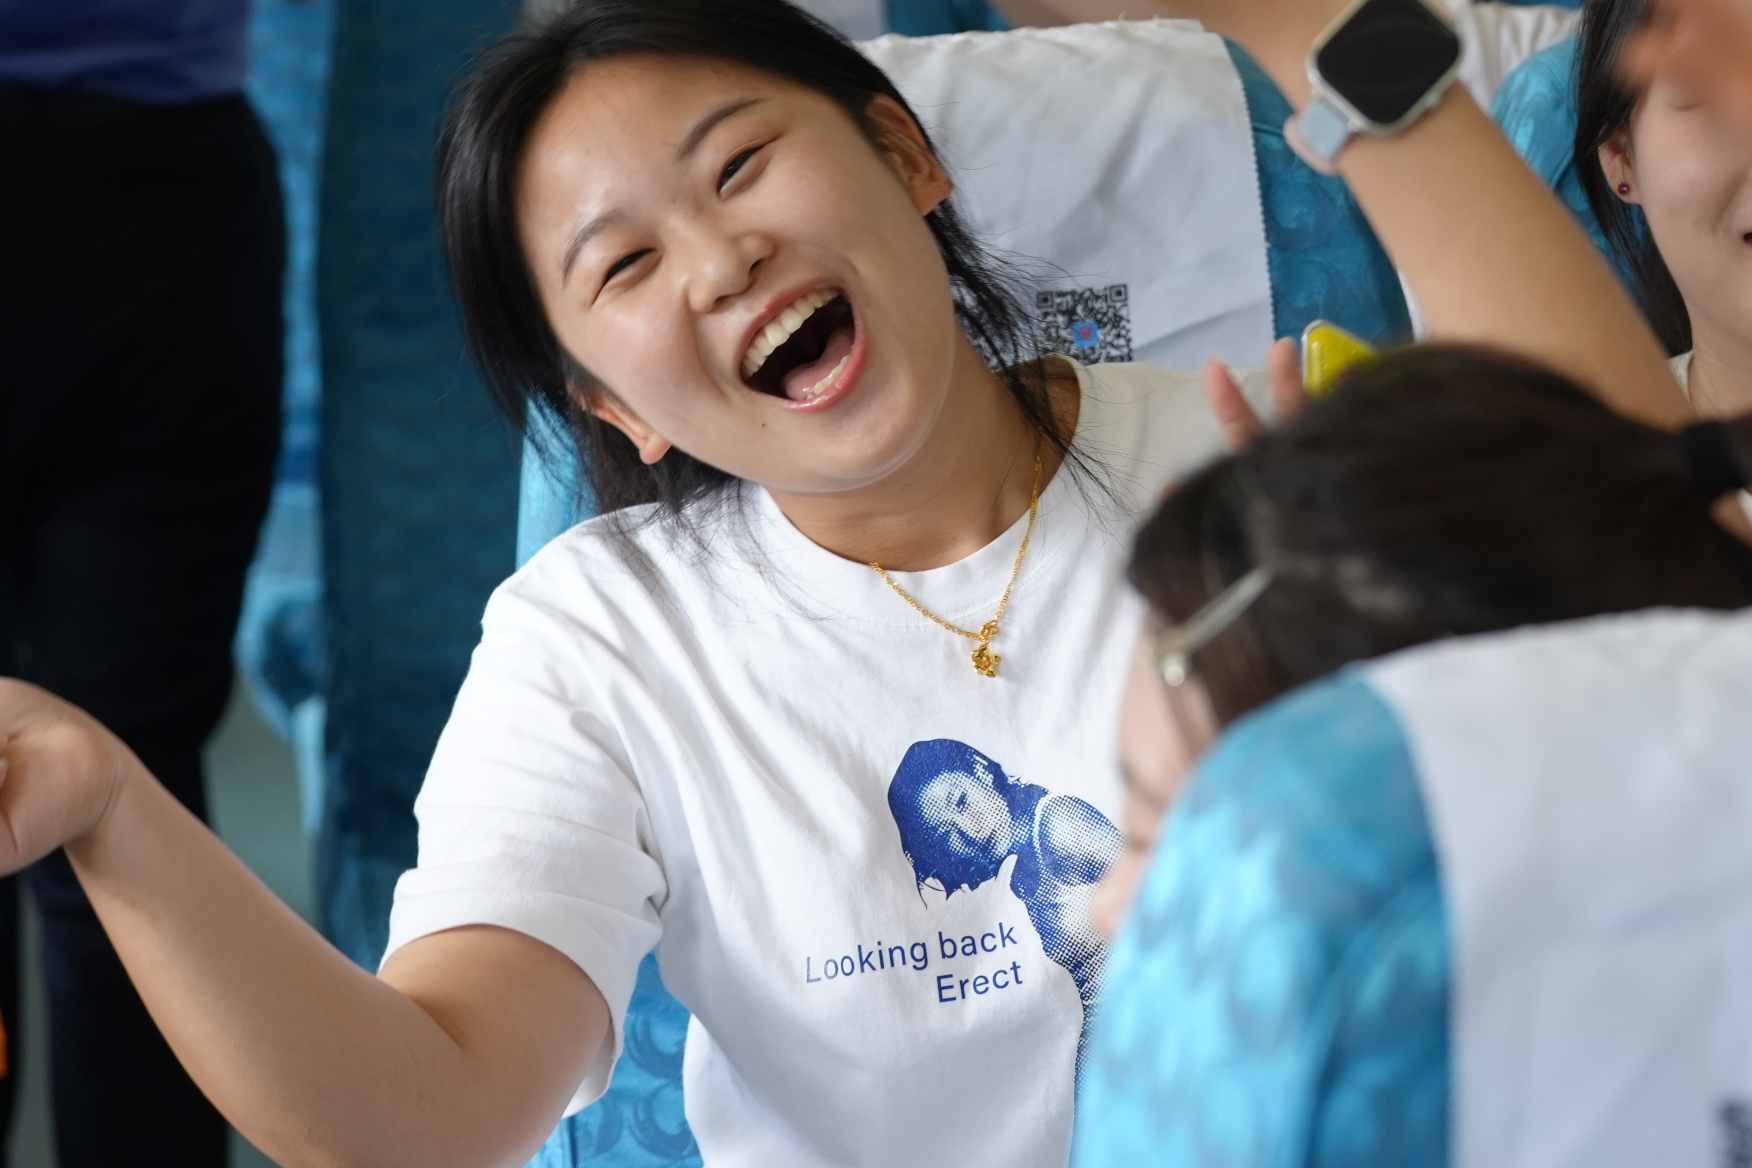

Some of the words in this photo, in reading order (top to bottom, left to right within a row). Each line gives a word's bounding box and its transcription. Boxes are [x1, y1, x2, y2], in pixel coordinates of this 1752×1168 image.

[806, 940, 929, 983] Looking
[938, 921, 1018, 959] back
[936, 960, 1023, 1003] Erect
